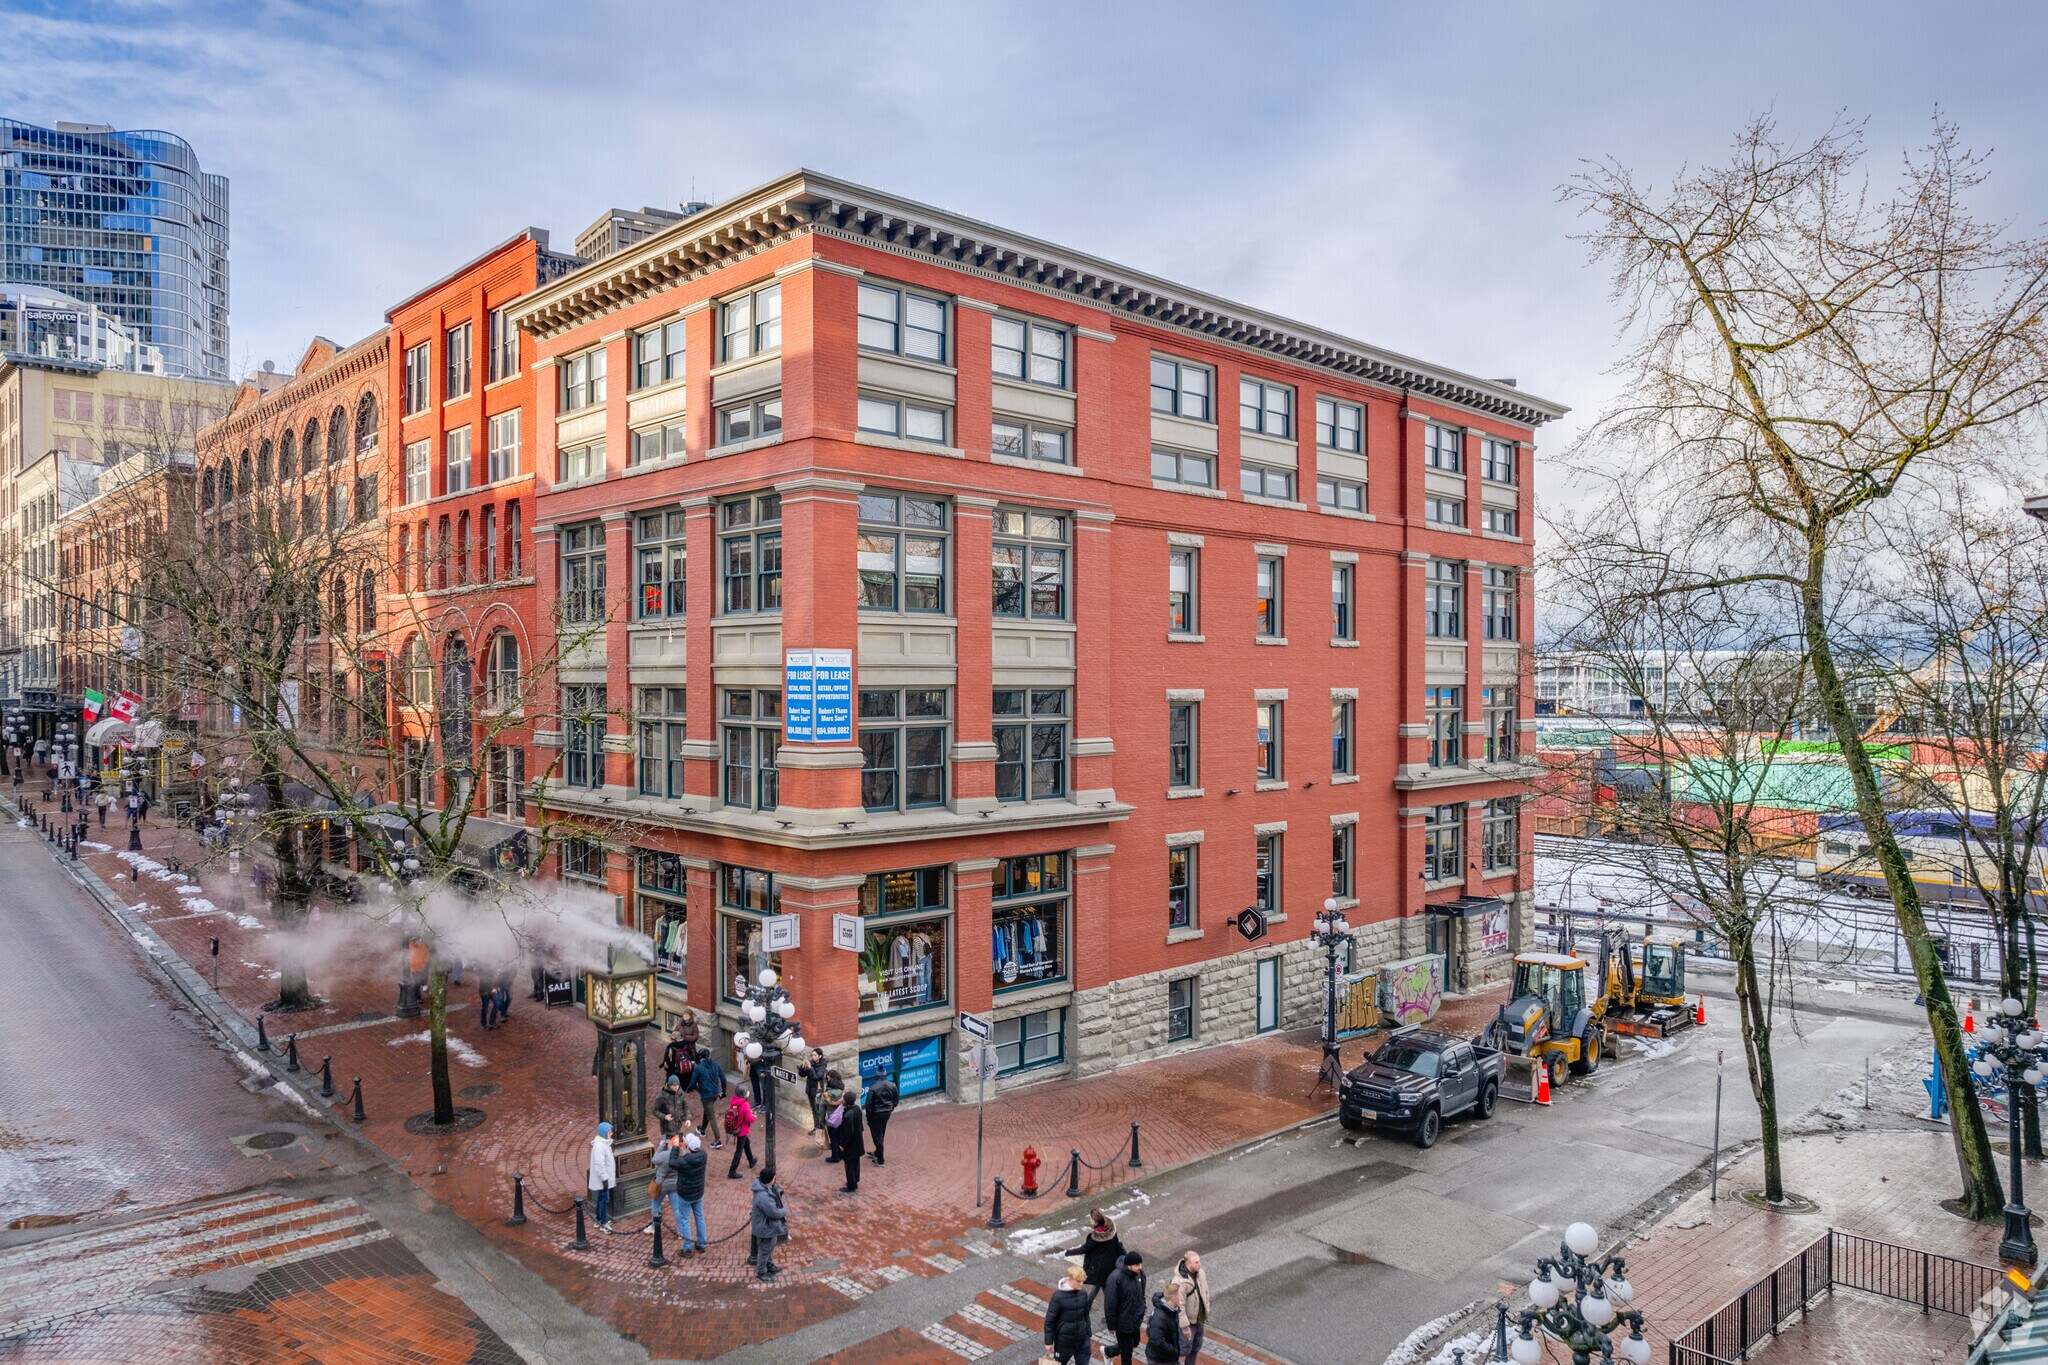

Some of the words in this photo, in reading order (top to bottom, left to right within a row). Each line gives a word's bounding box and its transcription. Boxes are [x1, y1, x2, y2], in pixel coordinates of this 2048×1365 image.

[28, 311, 77, 322] salesforce
[787, 671, 796, 680] FOR
[797, 671, 812, 680] LEASE
[816, 671, 829, 680] FOR
[830, 671, 850, 680] LEASE
[879, 969, 893, 977] VISIT
[895, 967, 903, 975] US
[548, 981, 571, 993] SALE
[877, 991, 889, 1000] THE
[890, 987, 908, 998] LATEST
[910, 983, 928, 994] SCOOP
[862, 1052, 893, 1069] corbel
[900, 1075, 936, 1089] OPPORTUNITY
